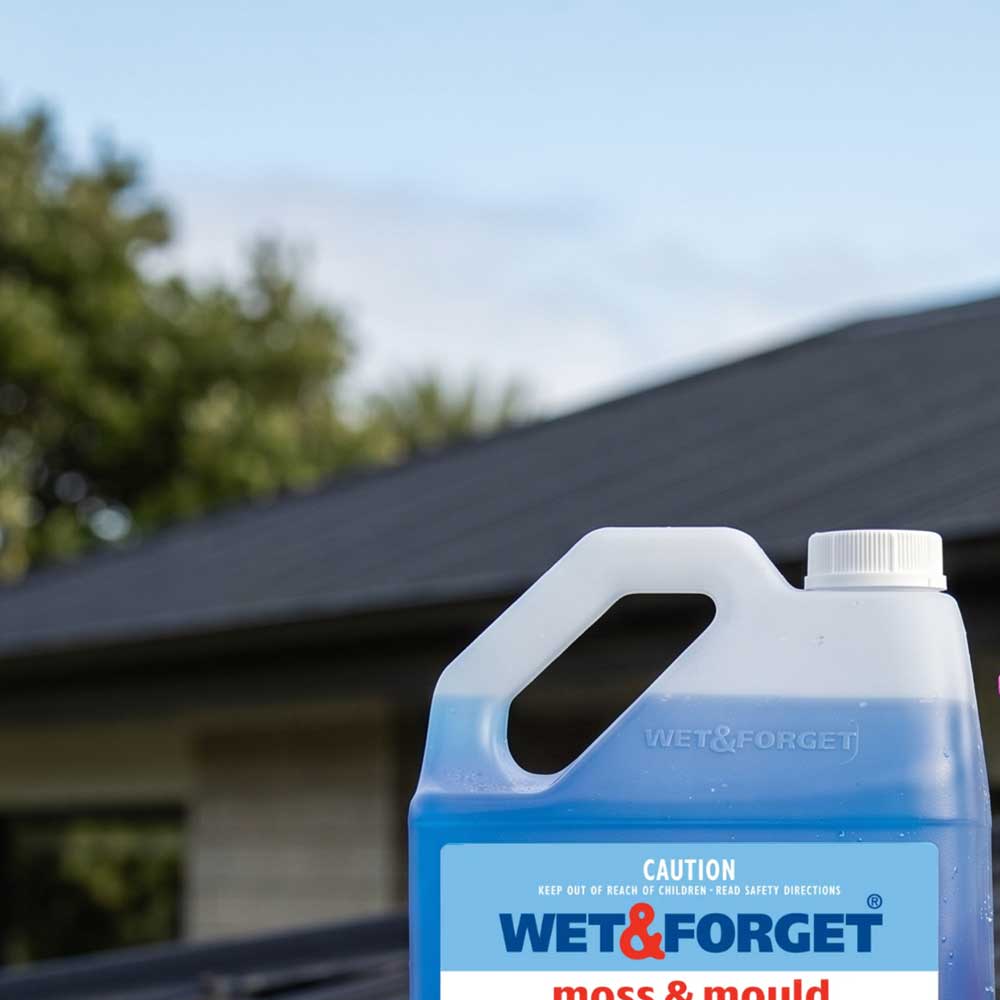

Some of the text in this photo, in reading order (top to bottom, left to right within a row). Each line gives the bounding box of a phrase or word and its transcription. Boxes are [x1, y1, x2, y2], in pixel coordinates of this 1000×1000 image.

[645, 726, 857, 753] WET&FORGET
[643, 858, 736, 881] CAUTION
[538, 885, 841, 896] KEEP OUT OF REACH OF CHILDREN READ SAFETY DIRECTIONS
[499, 902, 883, 960] WET&FORGET
